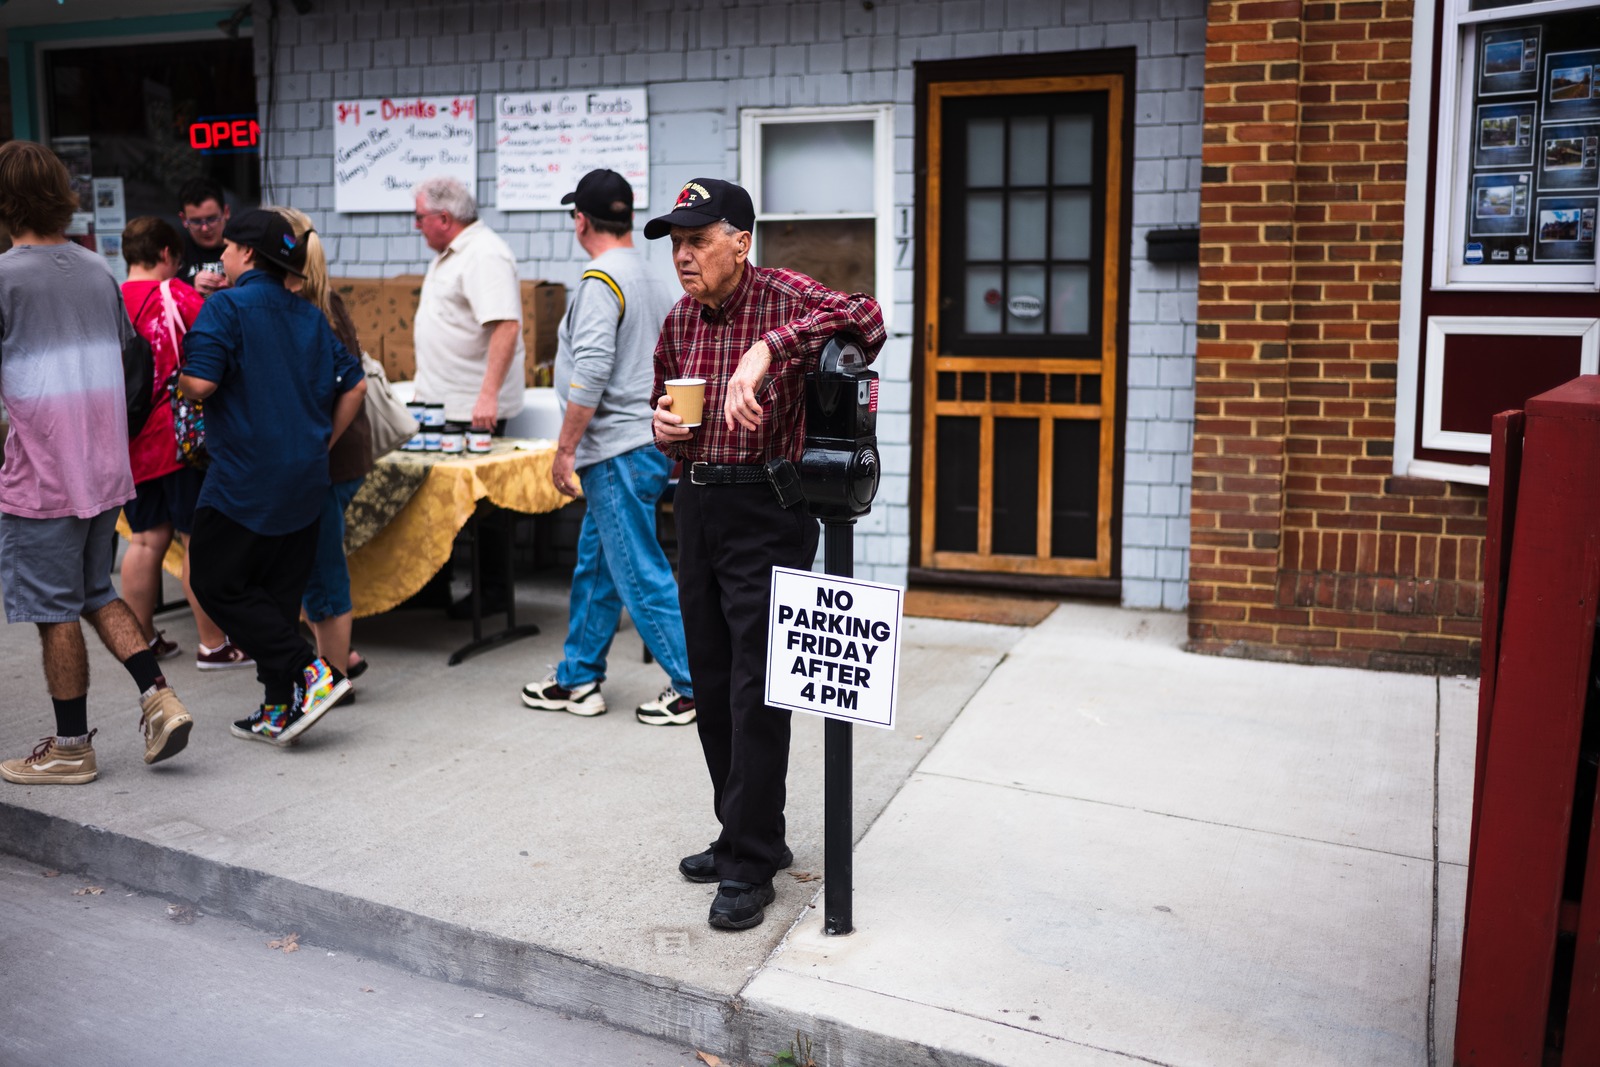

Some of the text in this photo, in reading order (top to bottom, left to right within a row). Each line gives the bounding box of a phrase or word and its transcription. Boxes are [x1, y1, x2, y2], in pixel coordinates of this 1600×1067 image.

[337, 102, 360, 127] $4
[381, 98, 437, 121] Drinks
[451, 98, 475, 121] $4
[586, 94, 633, 114] Foods
[189, 120, 261, 149] OPEN
[816, 587, 853, 611] NO
[778, 604, 891, 642] PARKING
[787, 630, 878, 664] FRIDAY
[790, 656, 870, 688] AFTER
[800, 682, 858, 710] 4 PM
